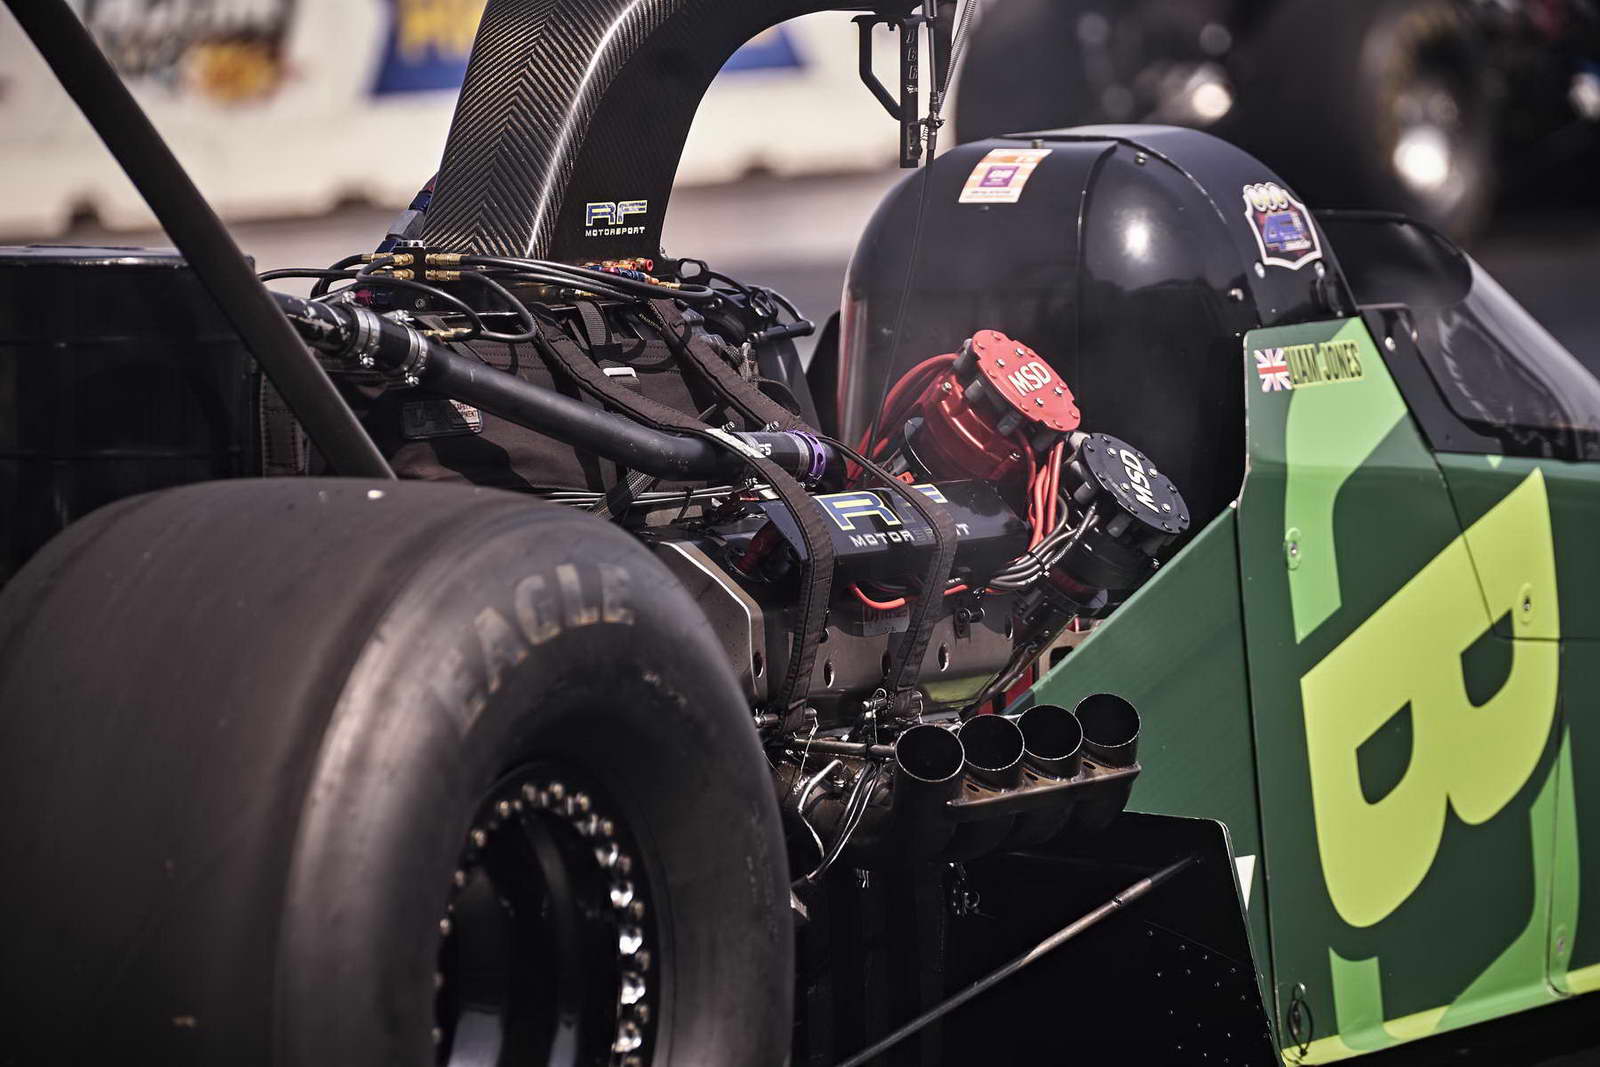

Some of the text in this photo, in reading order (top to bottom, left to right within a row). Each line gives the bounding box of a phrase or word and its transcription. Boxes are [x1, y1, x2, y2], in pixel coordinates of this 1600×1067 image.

[585, 199, 648, 226] RF
[585, 226, 646, 237] MOTORSPORT
[1008, 361, 1052, 397] MSD
[1322, 342, 1362, 381] JONES
[1119, 449, 1160, 513] MSD
[432, 563, 635, 738] EAGLE
